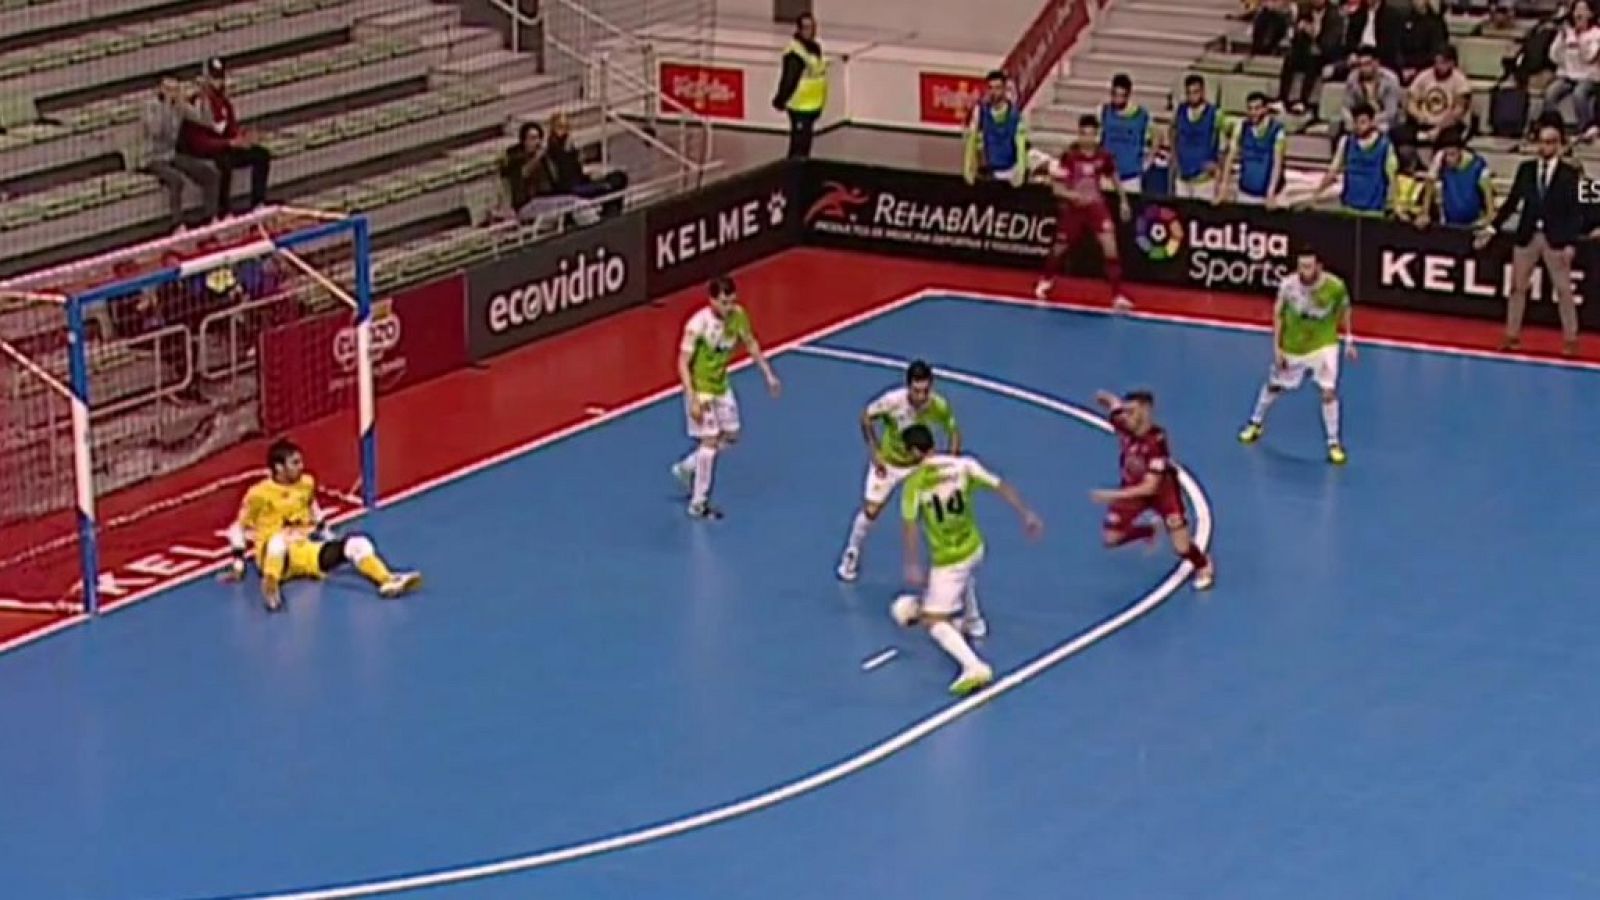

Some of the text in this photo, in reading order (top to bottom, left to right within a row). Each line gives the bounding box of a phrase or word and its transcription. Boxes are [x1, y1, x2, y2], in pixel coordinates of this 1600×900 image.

[656, 200, 760, 270] KELME
[1188, 220, 1289, 260] LaLiga
[1189, 250, 1289, 288] Sports
[490, 247, 625, 332] ecovidrio
[927, 488, 965, 523] 14
